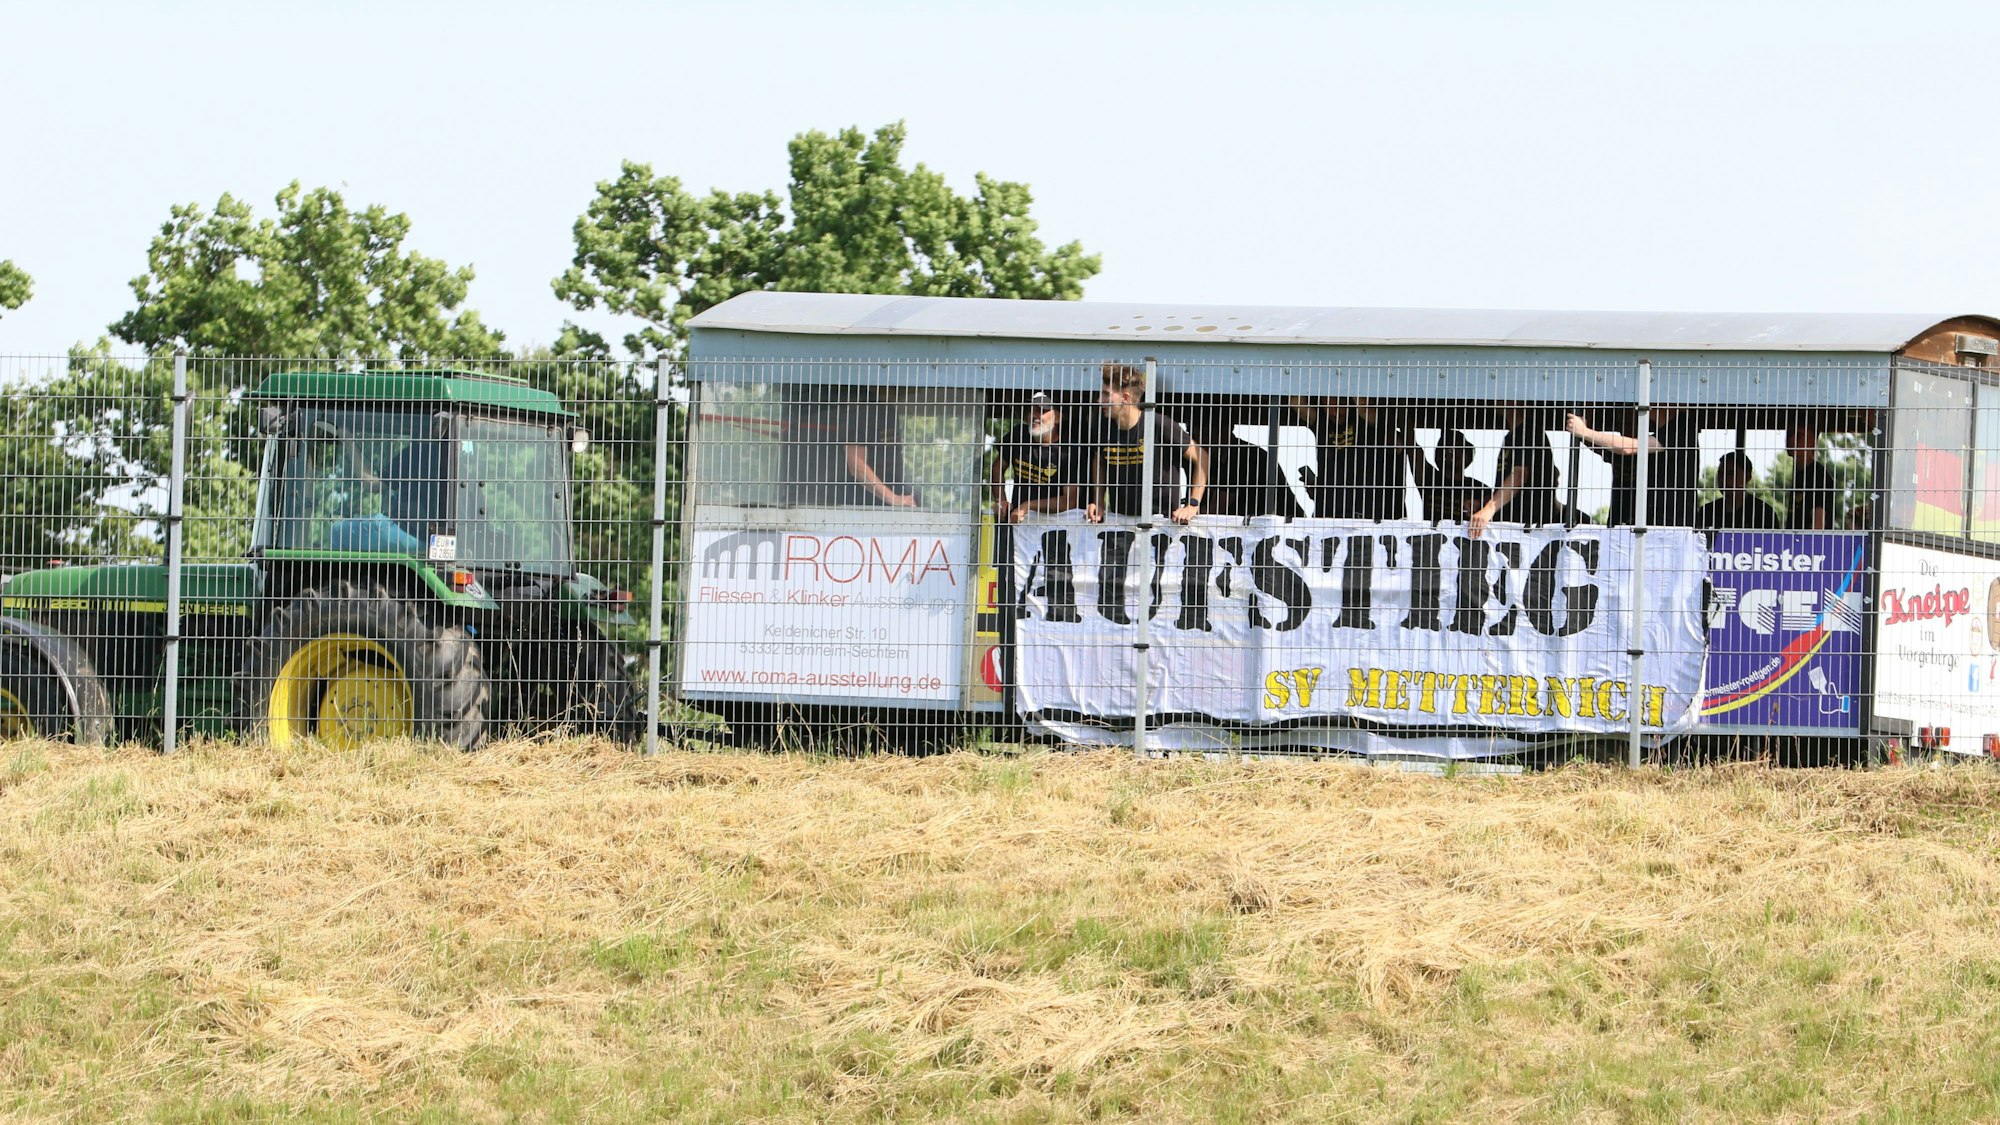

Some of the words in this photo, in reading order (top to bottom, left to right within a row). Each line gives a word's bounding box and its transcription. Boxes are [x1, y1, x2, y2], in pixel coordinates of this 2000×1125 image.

[784, 535, 956, 586] ROMA
[1918, 558, 1939, 577] Die
[1017, 529, 1599, 637] AUFSTIEG
[162, 602, 195, 613] JHN
[199, 604, 240, 615] DEERE
[699, 586, 764, 604] Fliesen
[770, 588, 785, 605] &
[787, 588, 849, 607] Klinker
[854, 591, 957, 615] Ausstellung
[1881, 582, 1971, 628] Kneipe
[764, 623, 841, 639] Keldenicher
[845, 626, 866, 640] Str.
[871, 627, 887, 641] 10
[1920, 625, 1935, 643] im
[740, 641, 779, 655] 53332
[784, 643, 909, 659] Bornheim-Sechtem
[1898, 644, 1960, 672] Vorgebirge
[701, 668, 941, 693] www.roma-ausstellung.de
[1702, 656, 1781, 698] ermeister-roettgen.de
[1264, 667, 1323, 710] SV
[1346, 668, 1667, 728] METTERNICH
